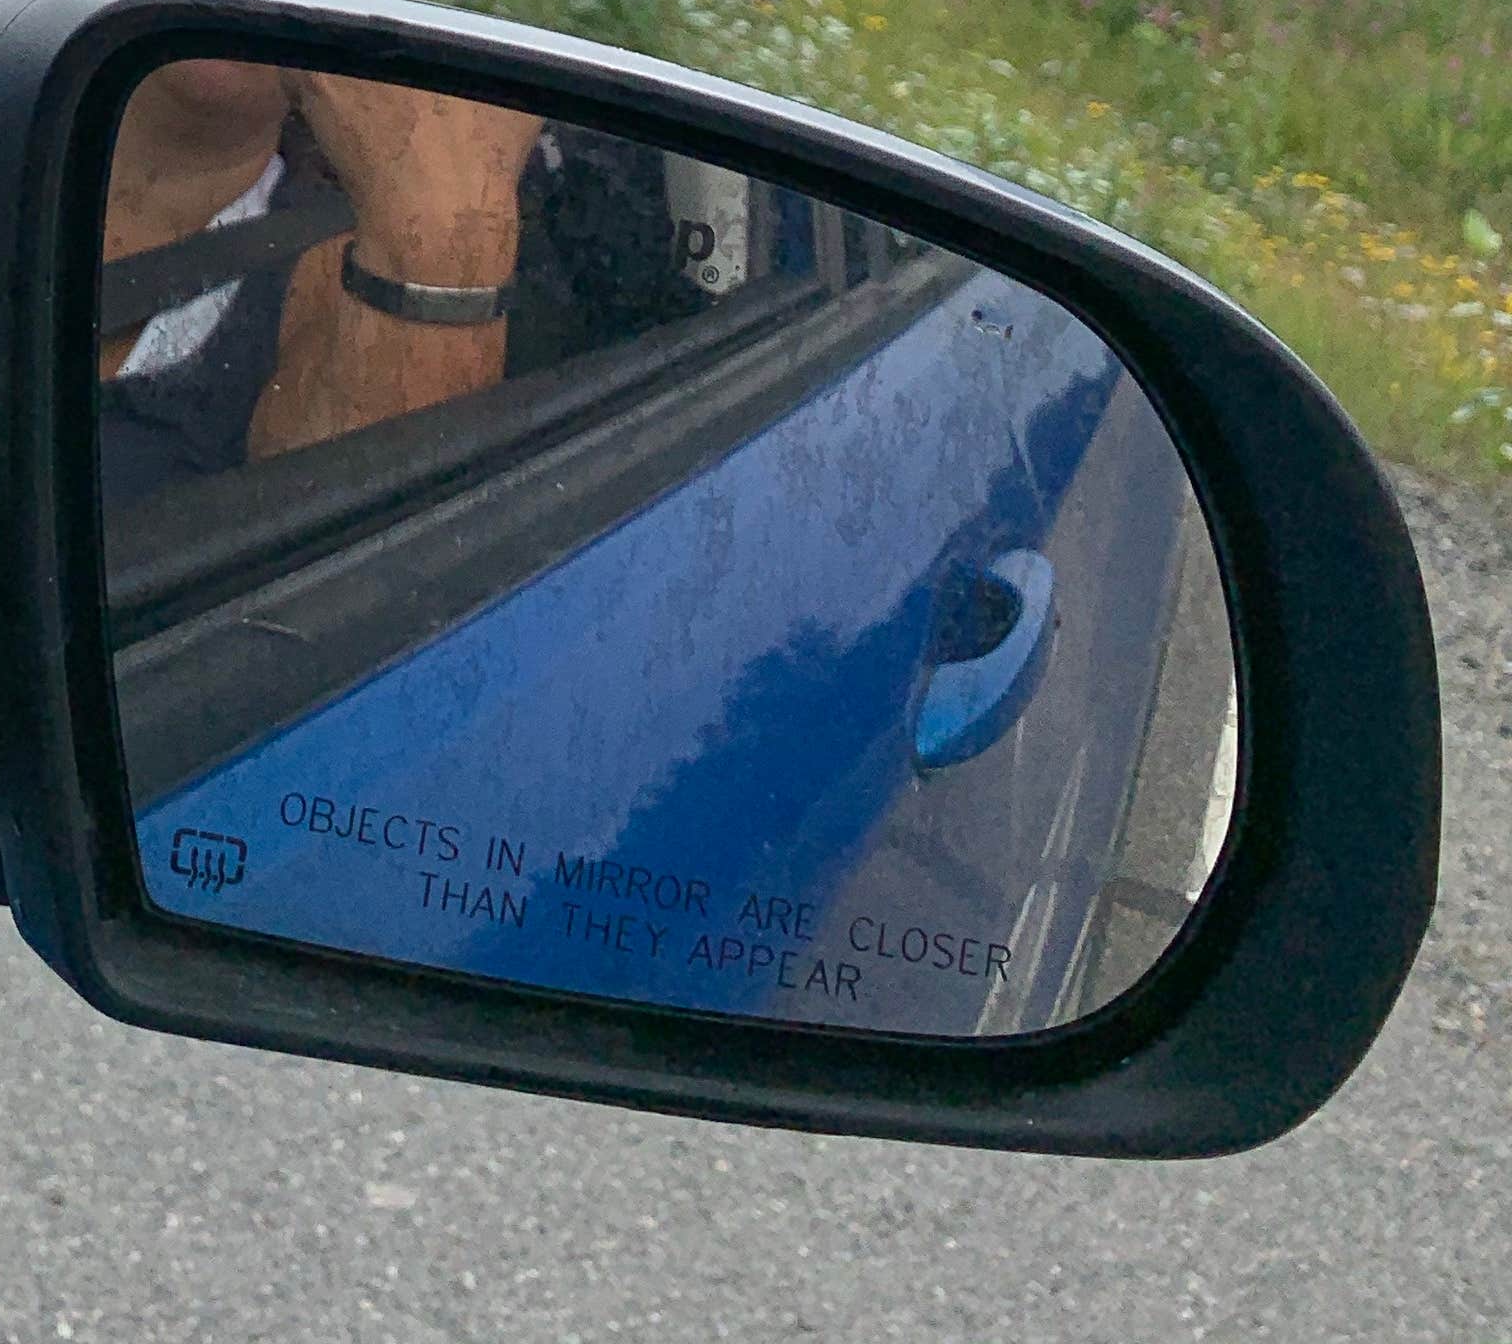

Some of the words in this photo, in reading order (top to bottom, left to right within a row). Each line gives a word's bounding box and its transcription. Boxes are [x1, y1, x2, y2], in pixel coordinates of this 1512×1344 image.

[279, 791, 460, 862] OBJECTS
[486, 837, 526, 874] IN
[554, 850, 711, 914] MIRROR
[738, 895, 815, 942] ARE
[848, 914, 1013, 982] CLOSER
[419, 872, 529, 929] THAN
[565, 902, 668, 957] THEY
[688, 933, 863, 1002] APPEAR
